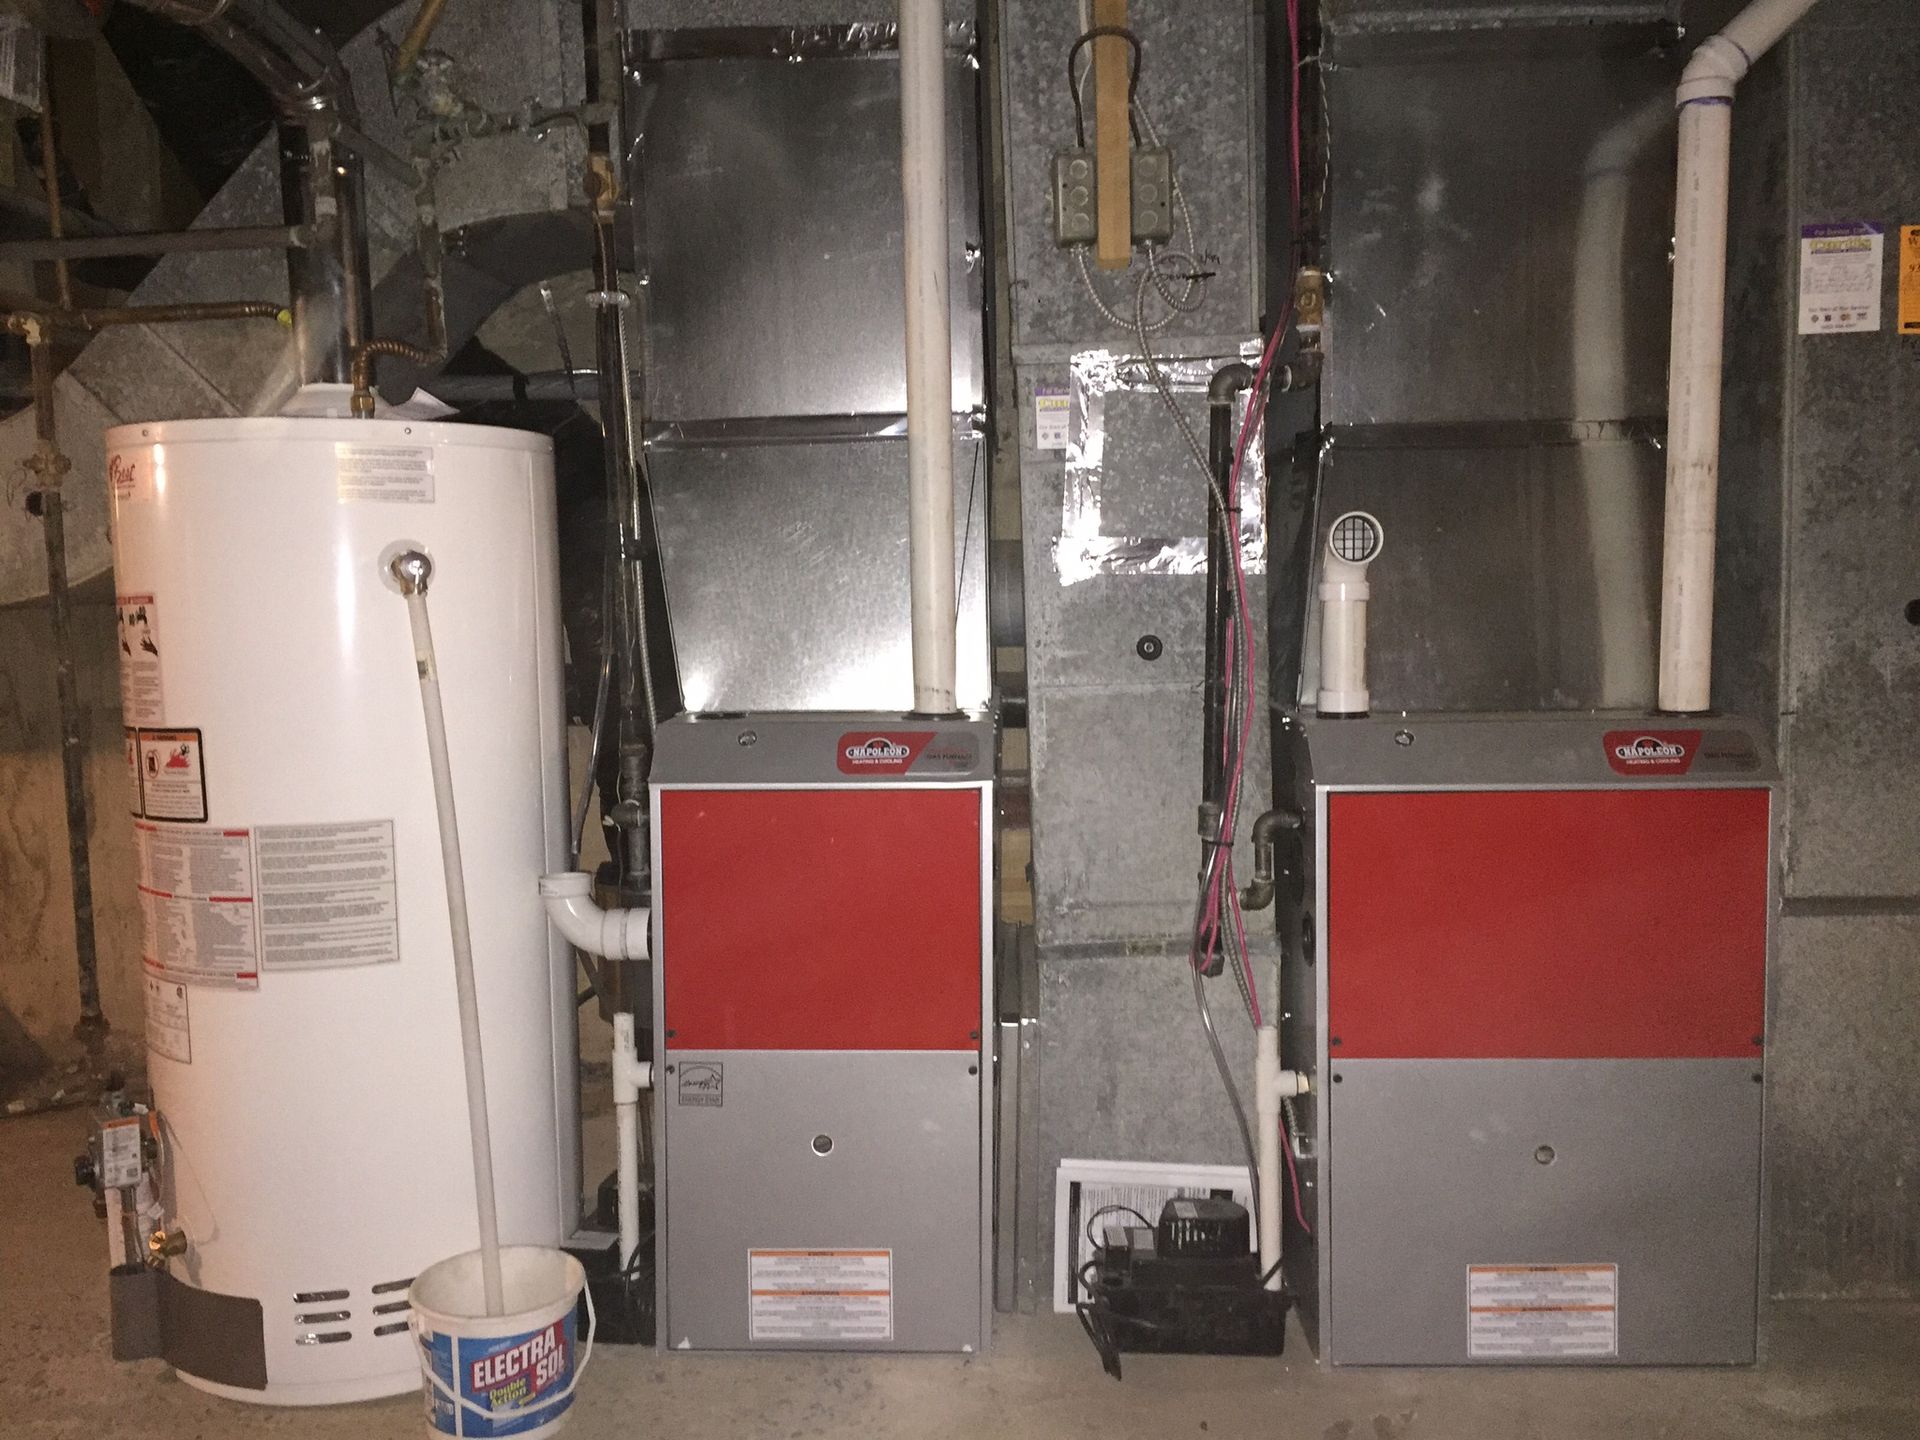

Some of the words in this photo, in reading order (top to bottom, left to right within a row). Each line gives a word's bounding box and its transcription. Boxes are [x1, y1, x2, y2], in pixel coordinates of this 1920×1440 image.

[854, 747, 903, 757] NAPOLEON
[1623, 746, 1676, 756] NAPOLEON
[473, 1326, 556, 1389] ELECTRA
[536, 1344, 565, 1386] SOL
[489, 1377, 527, 1401] Double
[490, 1386, 528, 1407] Action
